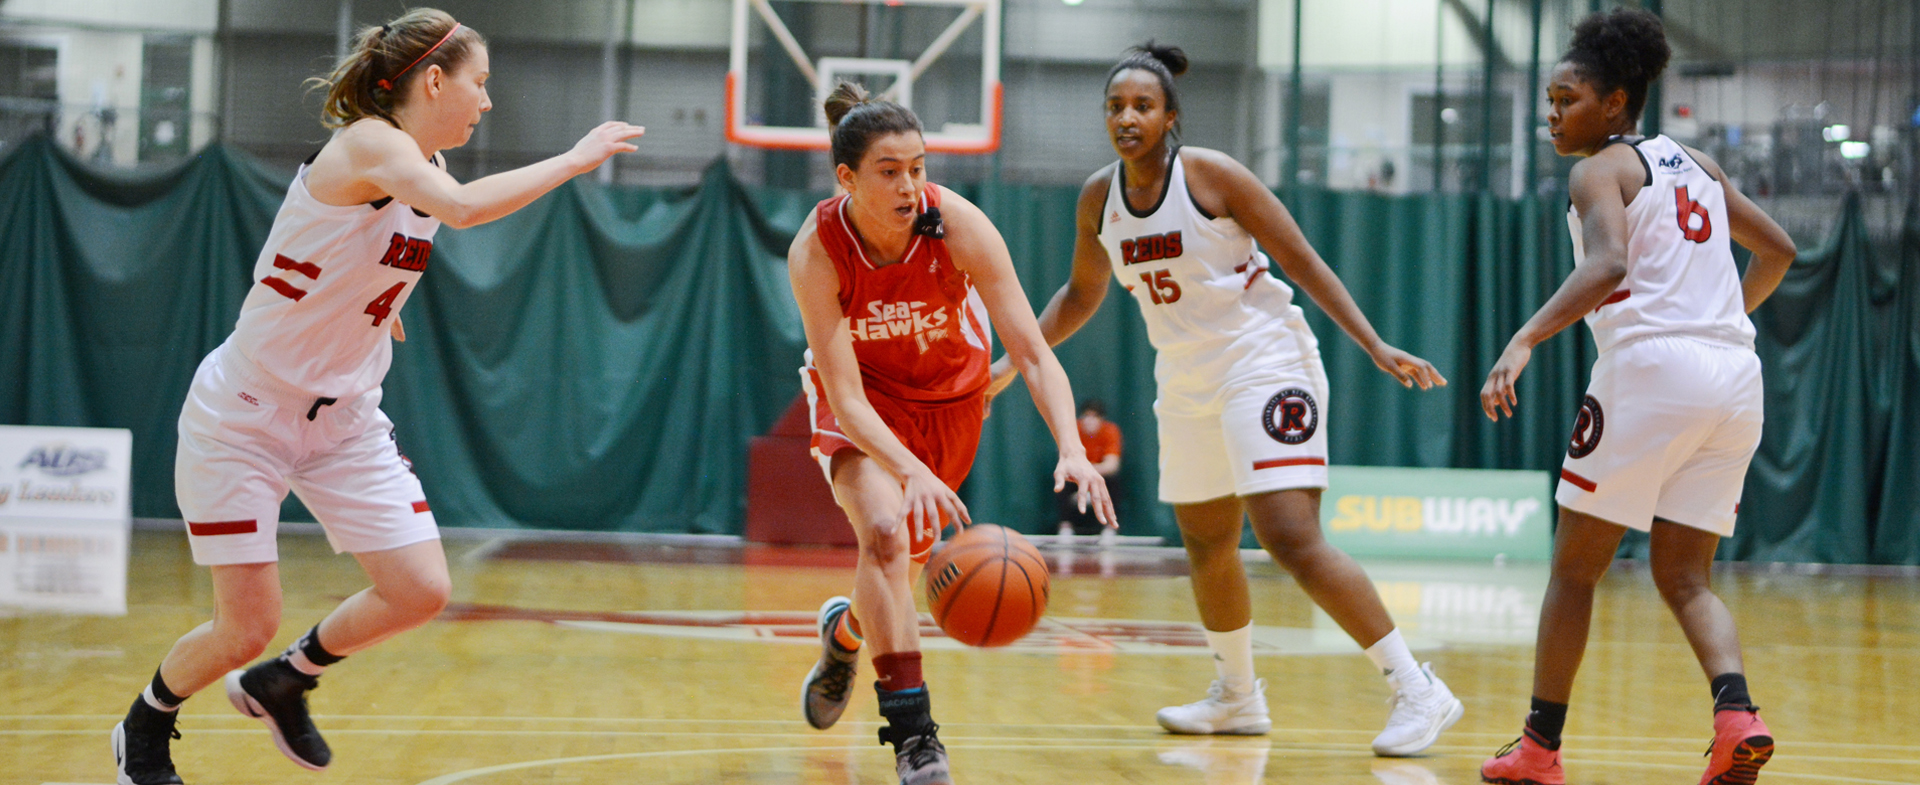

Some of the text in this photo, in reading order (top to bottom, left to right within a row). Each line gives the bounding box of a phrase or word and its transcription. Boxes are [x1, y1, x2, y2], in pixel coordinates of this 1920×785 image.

[1675, 184, 1712, 244] 6
[1120, 230, 1183, 266] REDS
[363, 281, 408, 327] 4
[1139, 268, 1182, 305] 15
[843, 306, 948, 340] Hawks
[1279, 400, 1307, 432] R
[1330, 495, 1539, 536] SUBWAY
